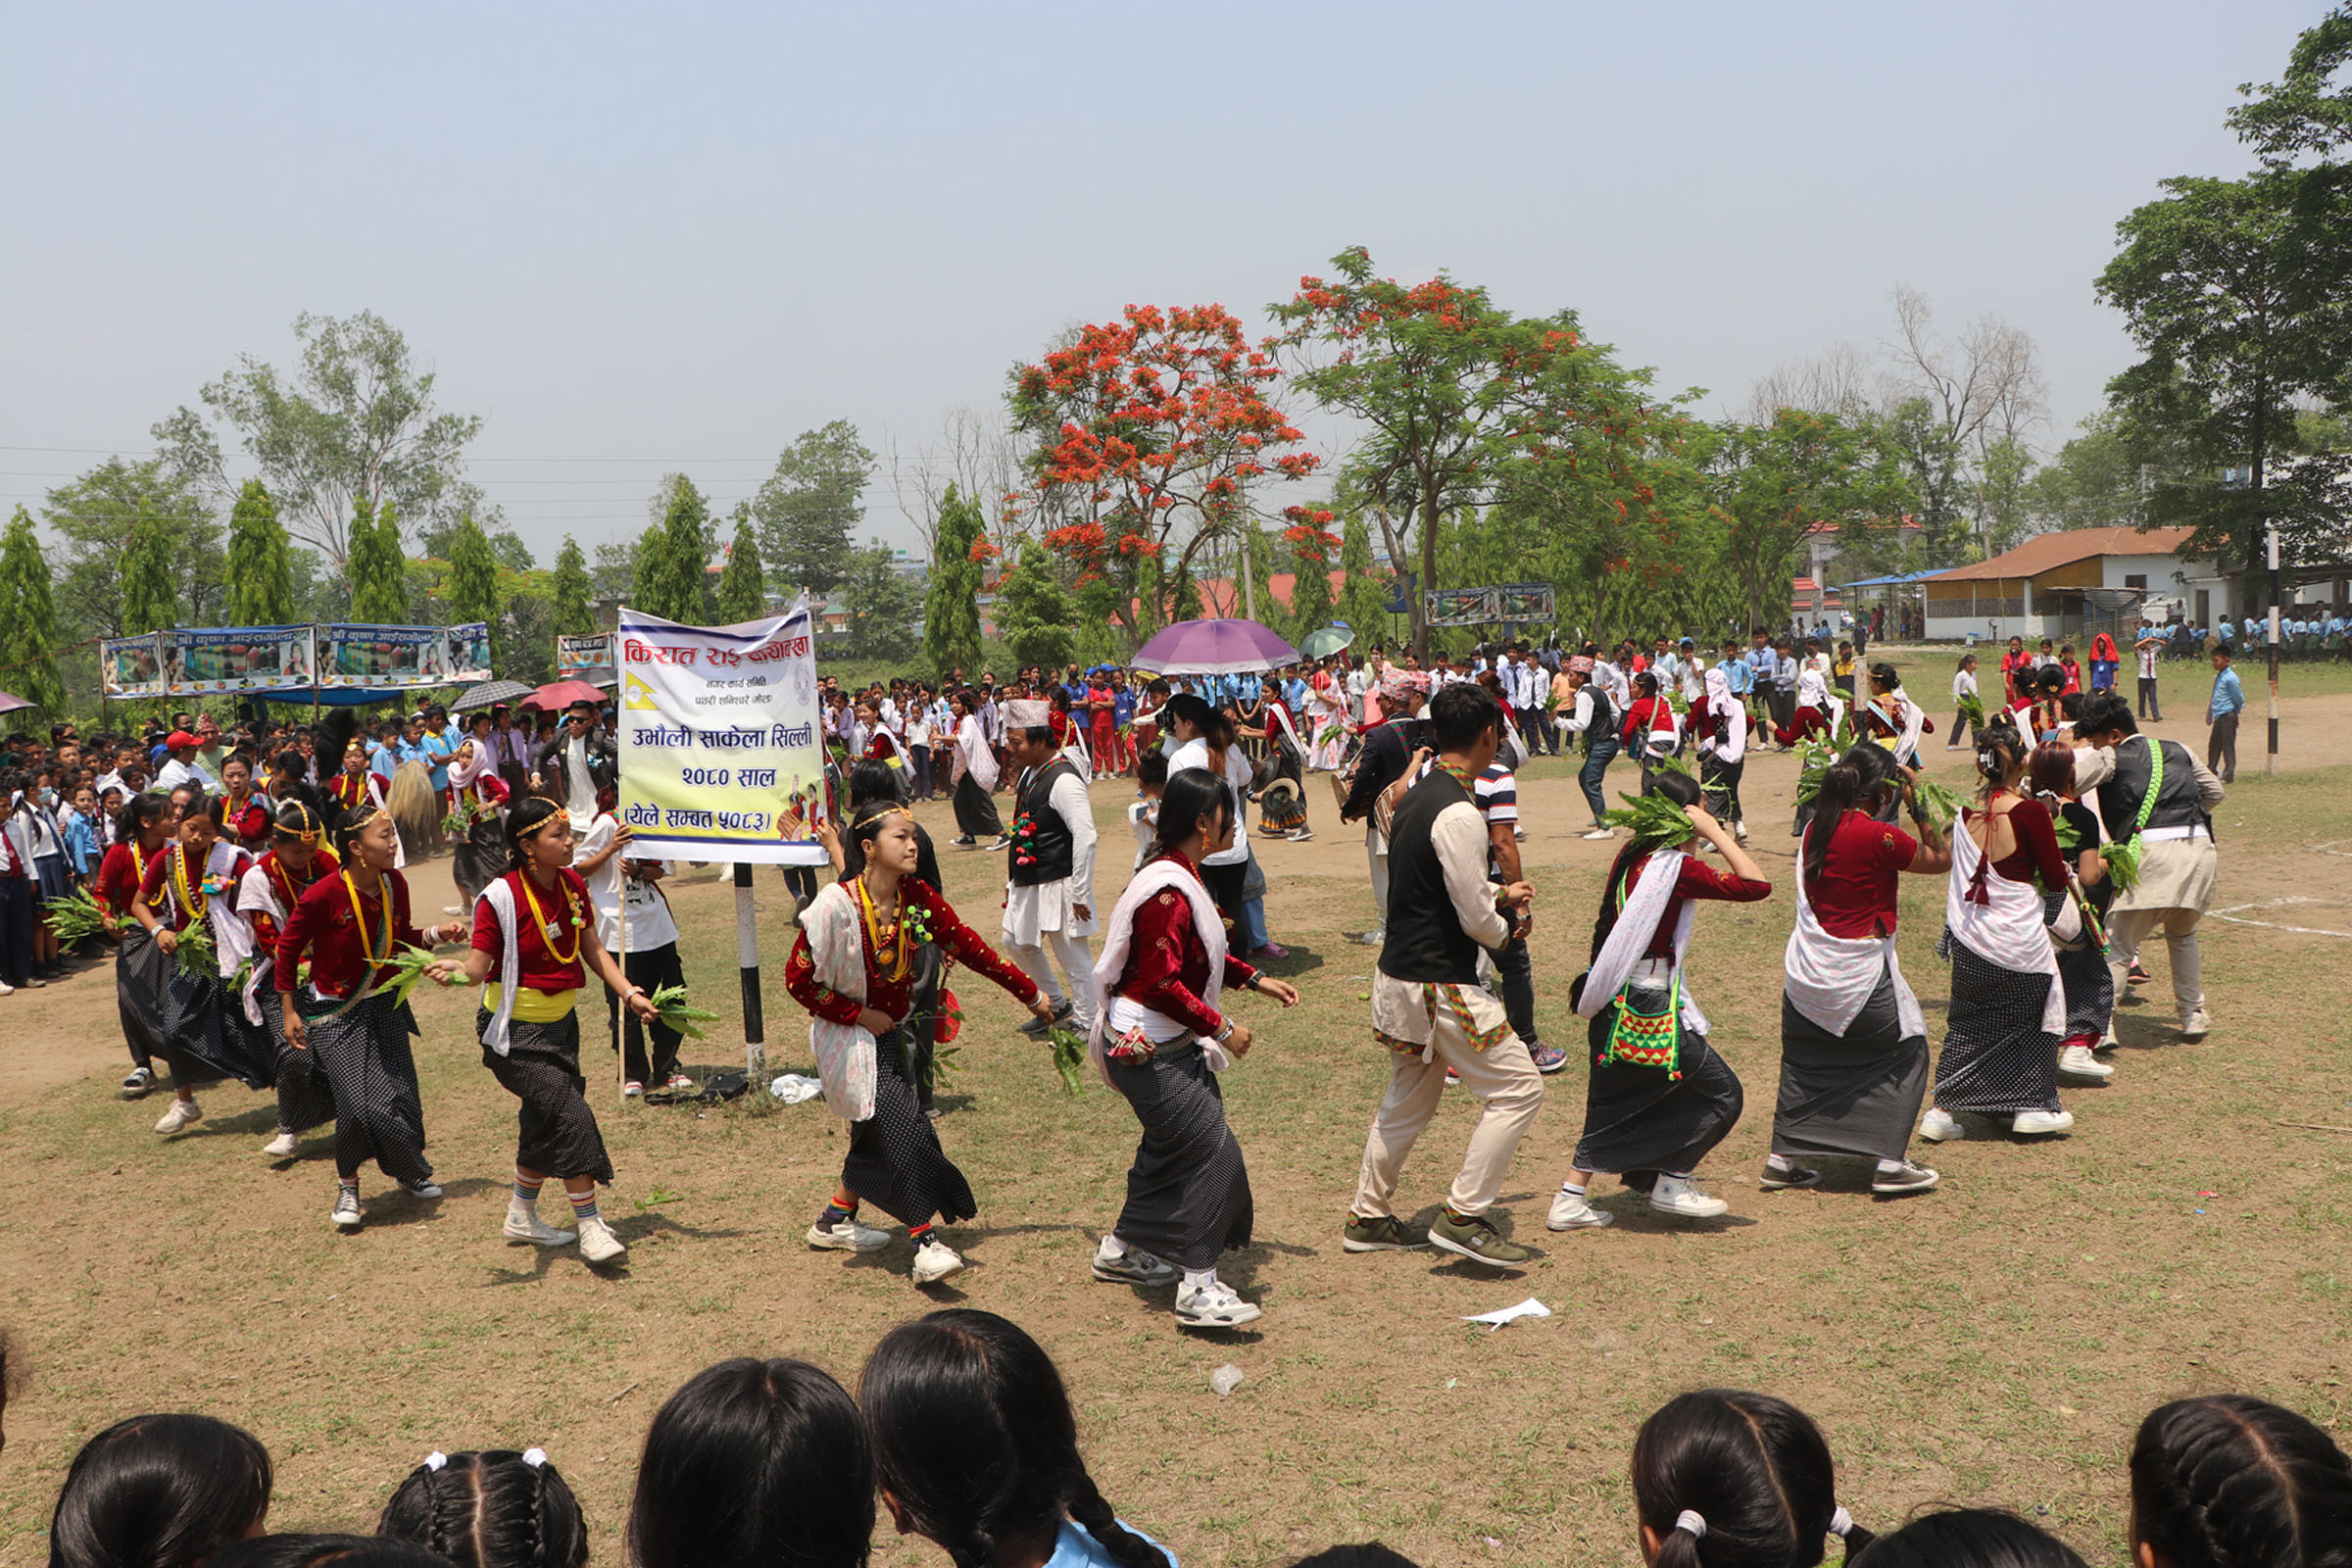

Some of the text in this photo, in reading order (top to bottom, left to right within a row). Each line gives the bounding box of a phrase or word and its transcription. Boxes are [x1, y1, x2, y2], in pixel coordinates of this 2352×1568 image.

[623, 638, 699, 665] किरात
[706, 680, 726, 689] नगर
[728, 677, 745, 689] कार्य
[632, 721, 812, 749] उभौली साकेला सिल्ली
[682, 767, 776, 788] २०८० साल
[624, 803, 771, 831] (येले सम्बत ५०८३)
